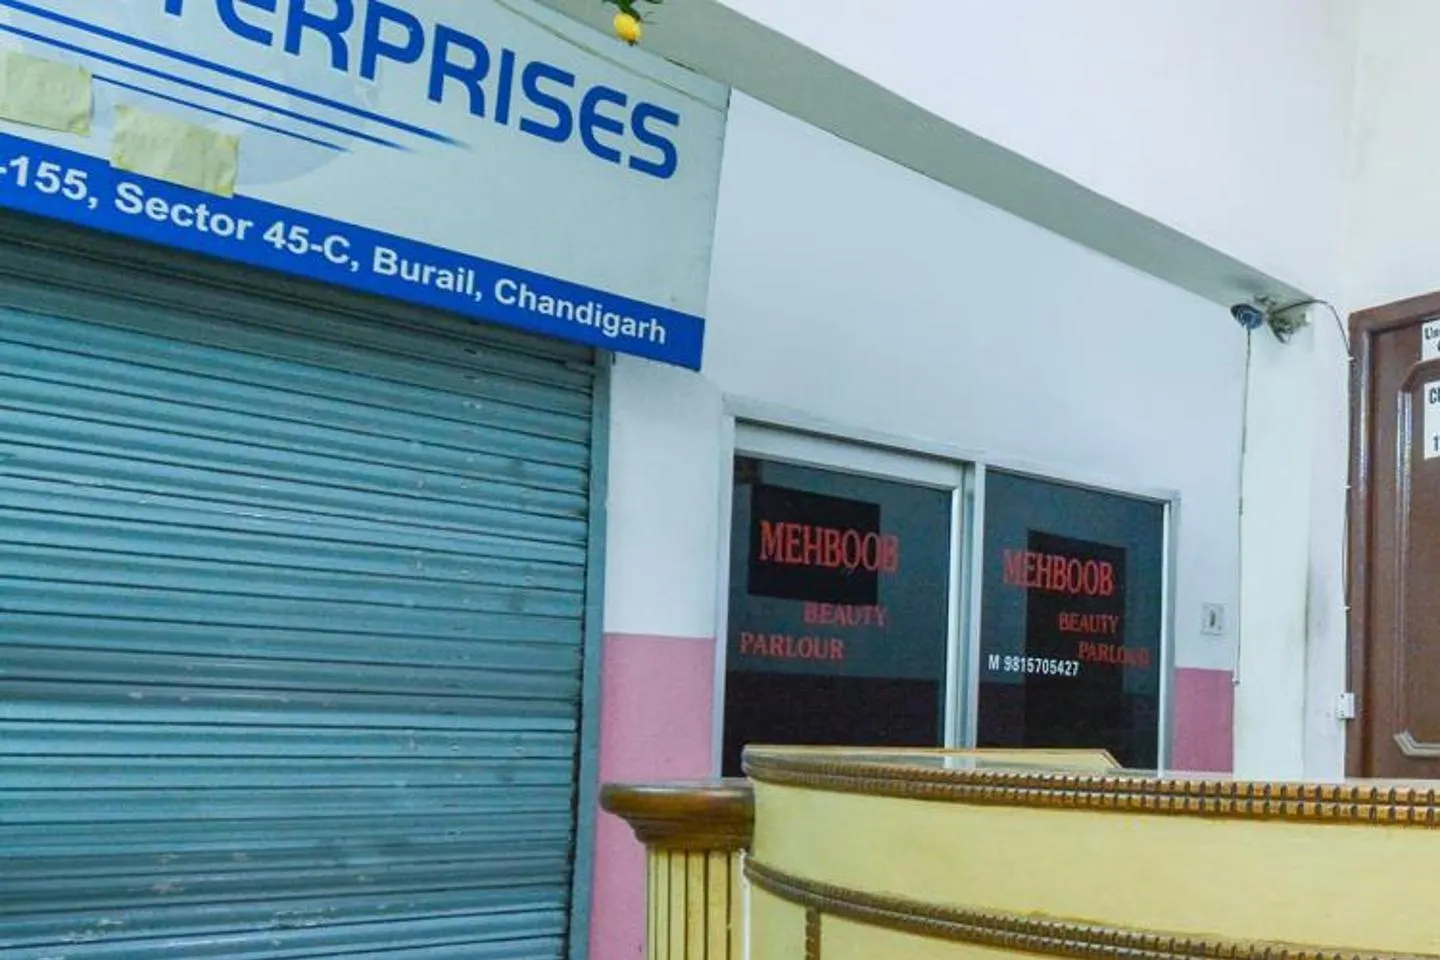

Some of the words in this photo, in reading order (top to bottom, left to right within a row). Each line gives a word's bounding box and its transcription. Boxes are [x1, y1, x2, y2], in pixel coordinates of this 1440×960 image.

[163, 0, 680, 180] ERPRISES
[114, 181, 253, 242] Sector
[263, 219, 359, 272] 45-C,
[372, 246, 483, 303] Burail,
[495, 278, 667, 347] Chandigarh
[759, 520, 898, 573] MEHBOOB
[1003, 549, 1113, 596] MEHBOOB
[804, 602, 887, 628] BEAUTY
[1059, 612, 1119, 636] BEAUTY
[739, 632, 844, 660] PARLOUR
[988, 654, 1000, 672] M
